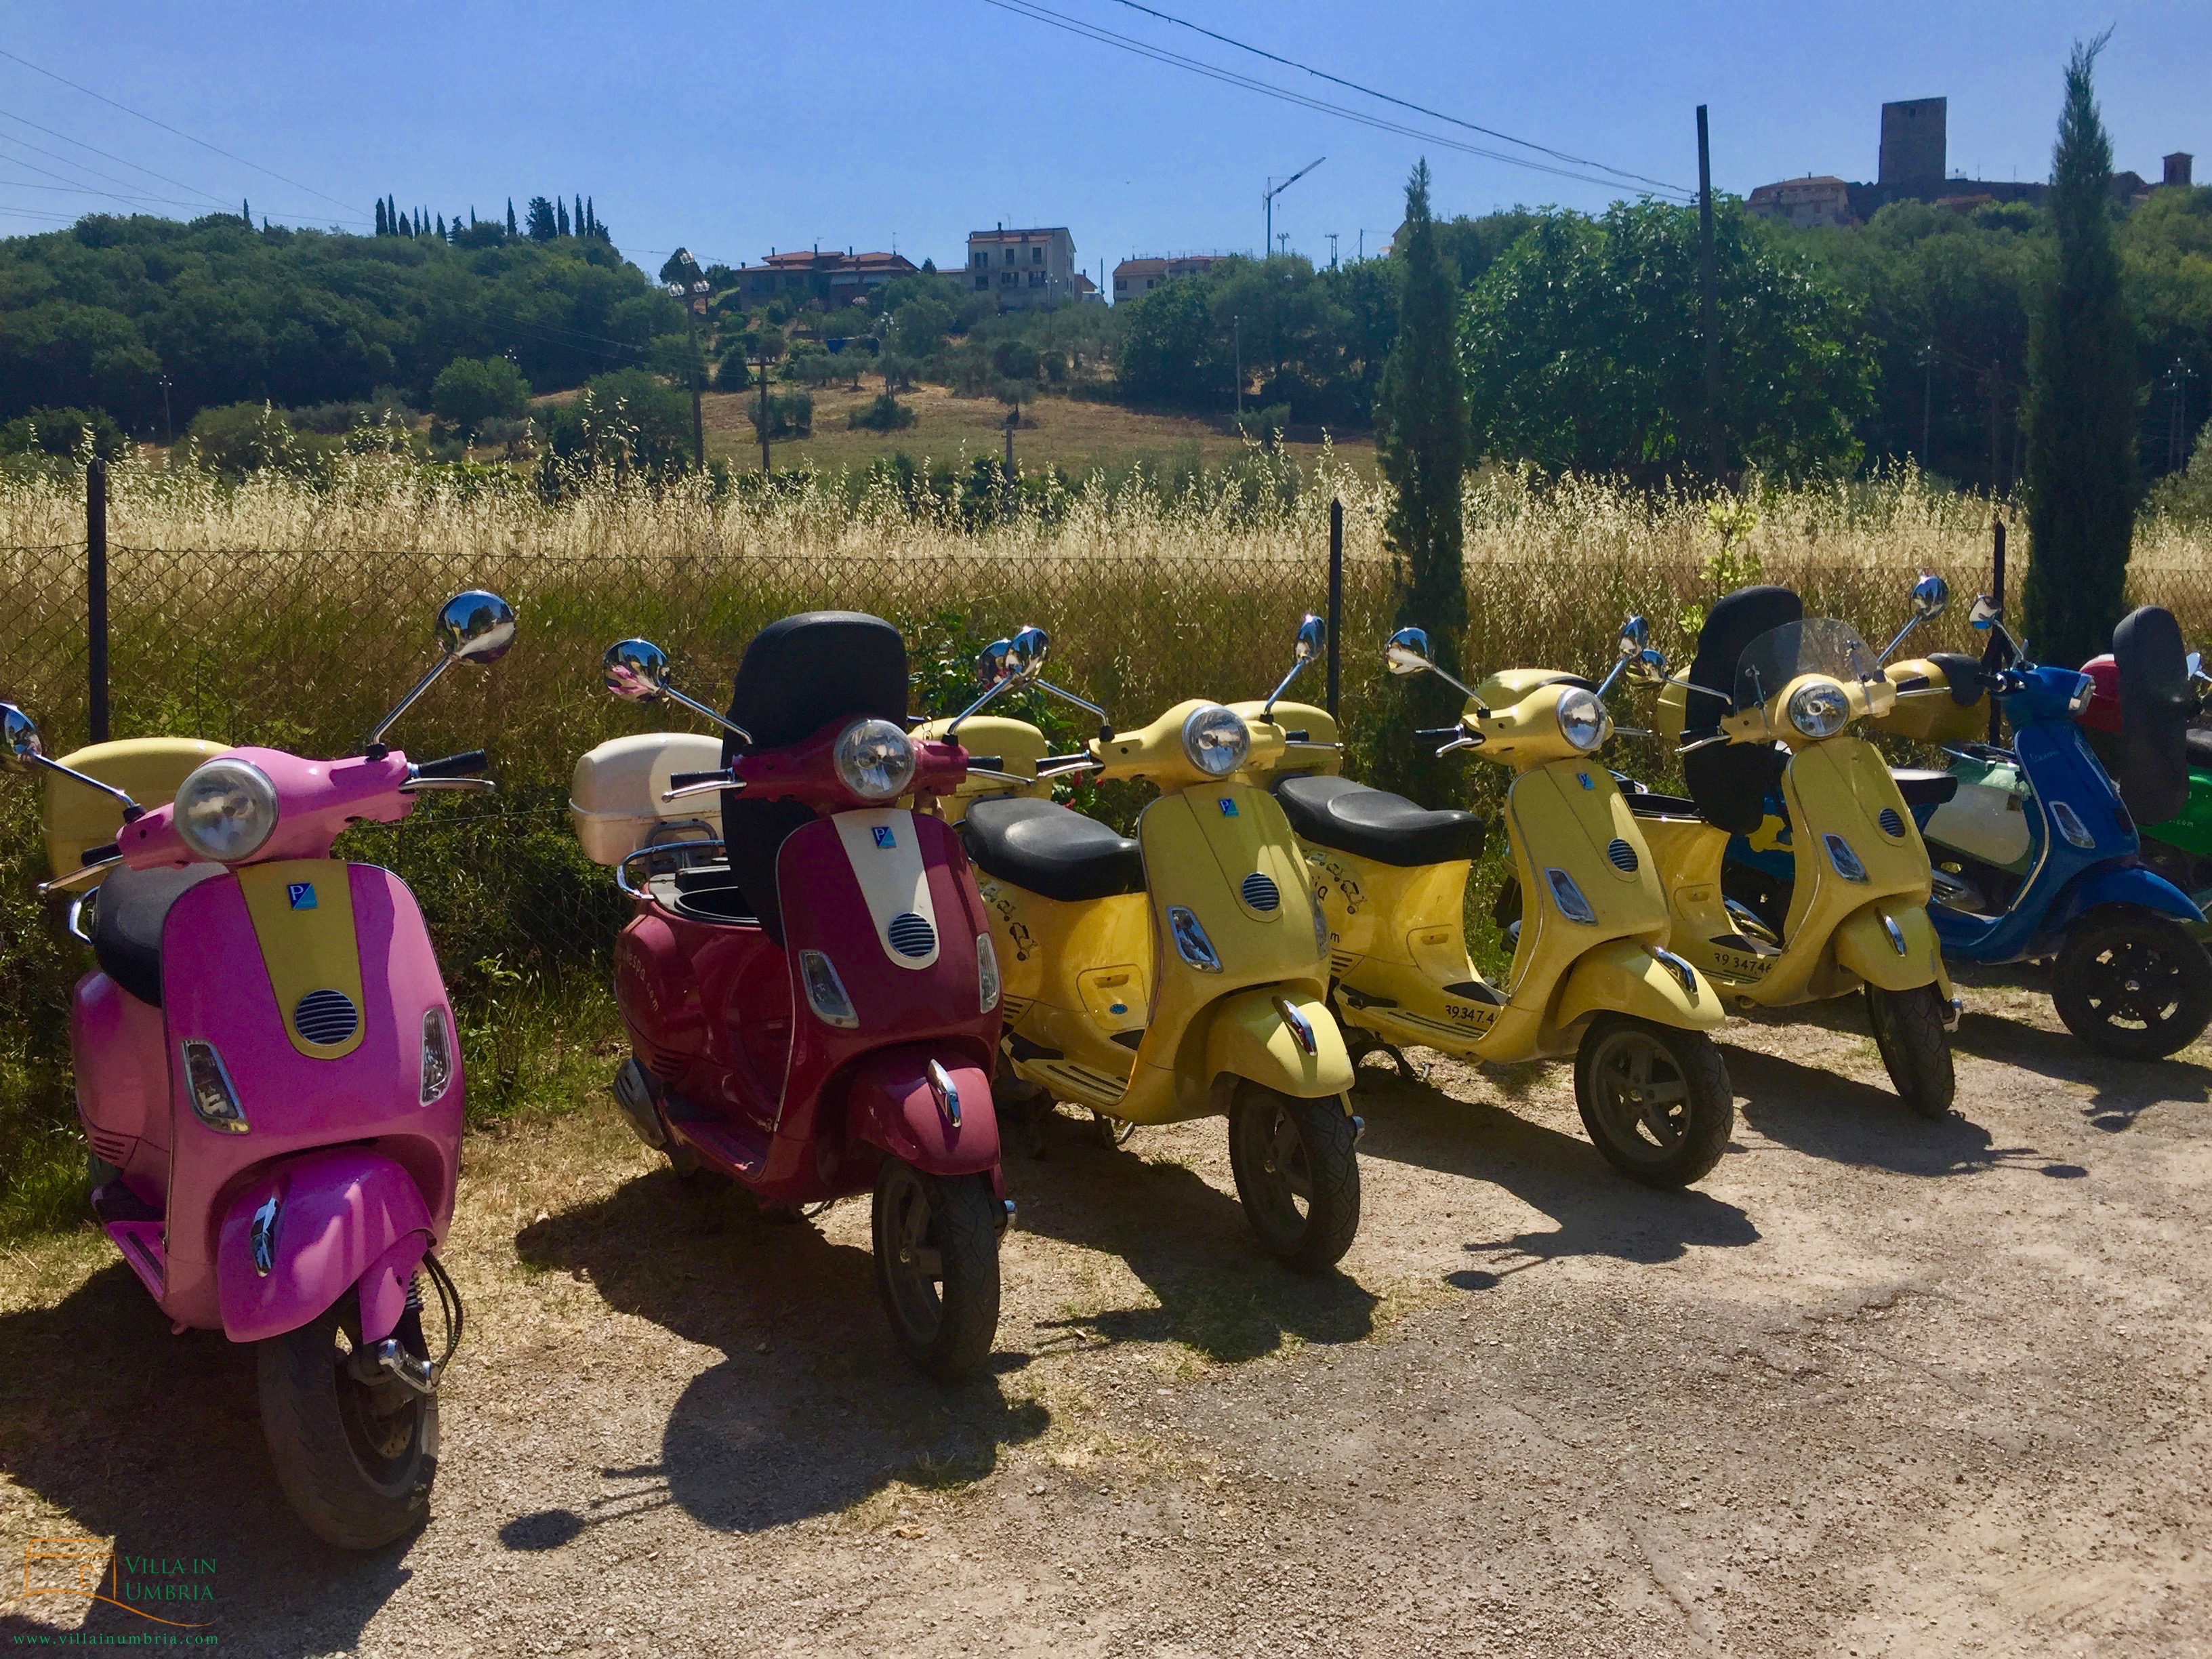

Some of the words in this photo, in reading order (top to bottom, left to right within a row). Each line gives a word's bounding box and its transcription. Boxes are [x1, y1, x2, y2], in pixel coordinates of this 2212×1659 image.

[1220, 800, 1229, 811] P
[874, 828, 885, 841] P
[289, 885, 304, 901] P
[1446, 1004, 1502, 1026] 39.347.4
